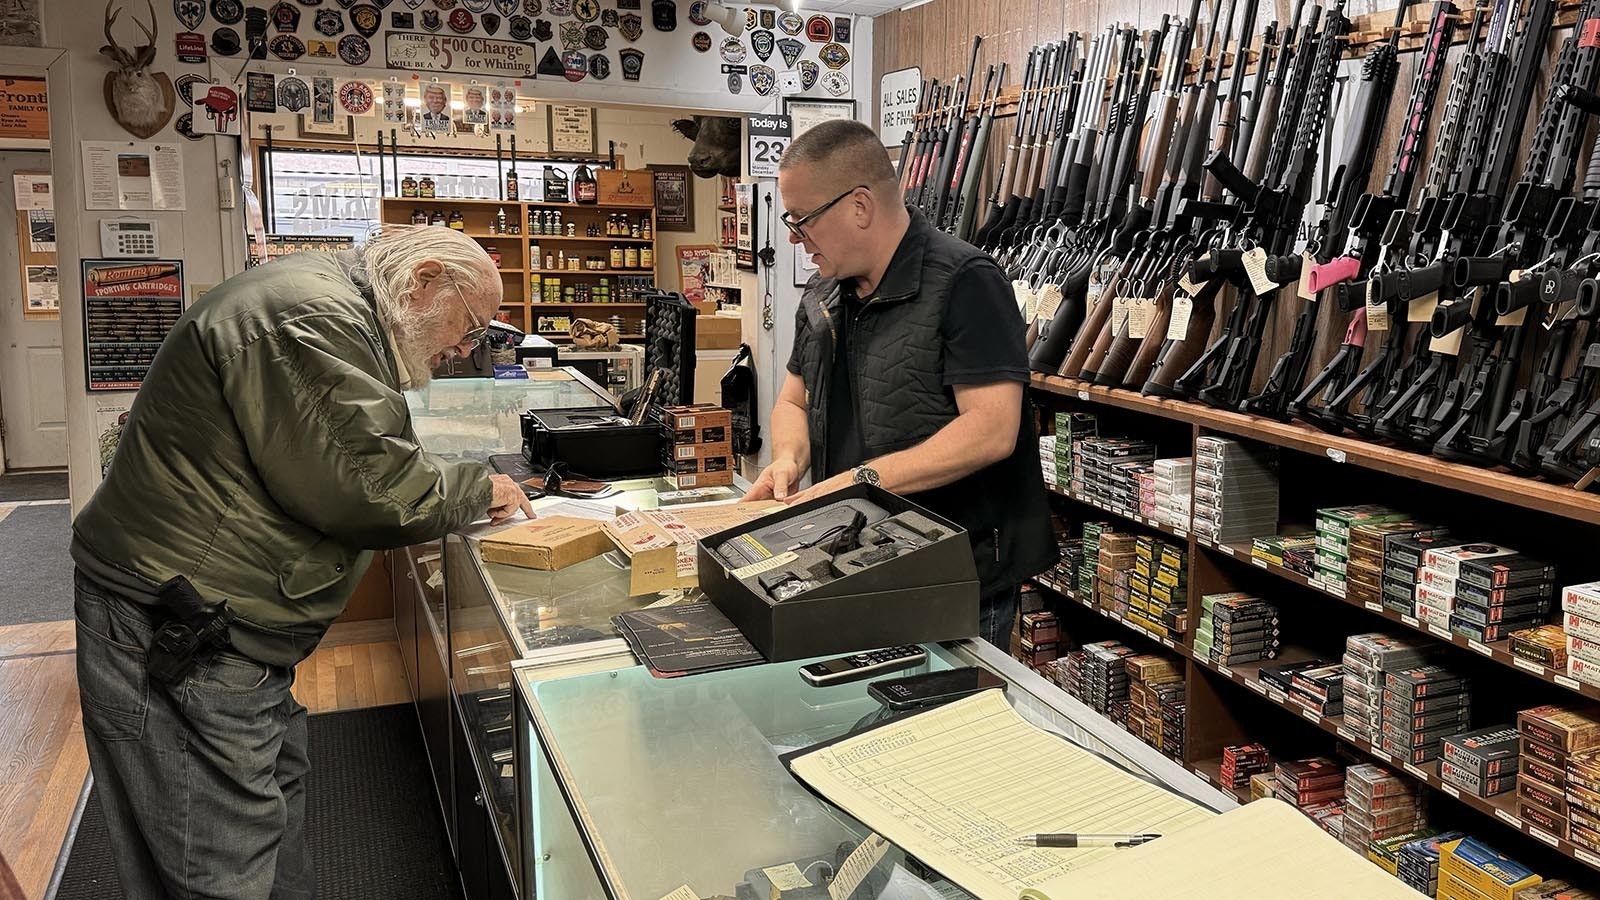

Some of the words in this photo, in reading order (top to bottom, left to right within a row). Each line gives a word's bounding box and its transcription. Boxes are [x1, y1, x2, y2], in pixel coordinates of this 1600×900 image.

[471, 39, 524, 60] Charge
[465, 56, 481, 68] for
[484, 58, 531, 74] Whining
[884, 92, 893, 107] ALL
[896, 88, 917, 106] SALES
[344, 102, 368, 112] TRUMP
[750, 118, 778, 130] Today
[780, 118, 788, 128] Is
[884, 112, 894, 127] ARE
[754, 140, 784, 163] 23
[106, 266, 162, 280] Remington
[96, 282, 130, 297] SPORTING
[132, 282, 177, 292] CARTRIDGES
[1437, 556, 1456, 566] MATCH
[1433, 574, 1452, 584] MATCH
[1428, 591, 1446, 601] MATCH
[1428, 608, 1447, 618] MATCH
[1515, 647, 1546, 660] FUSION
[1376, 832, 1416, 846] Remington
